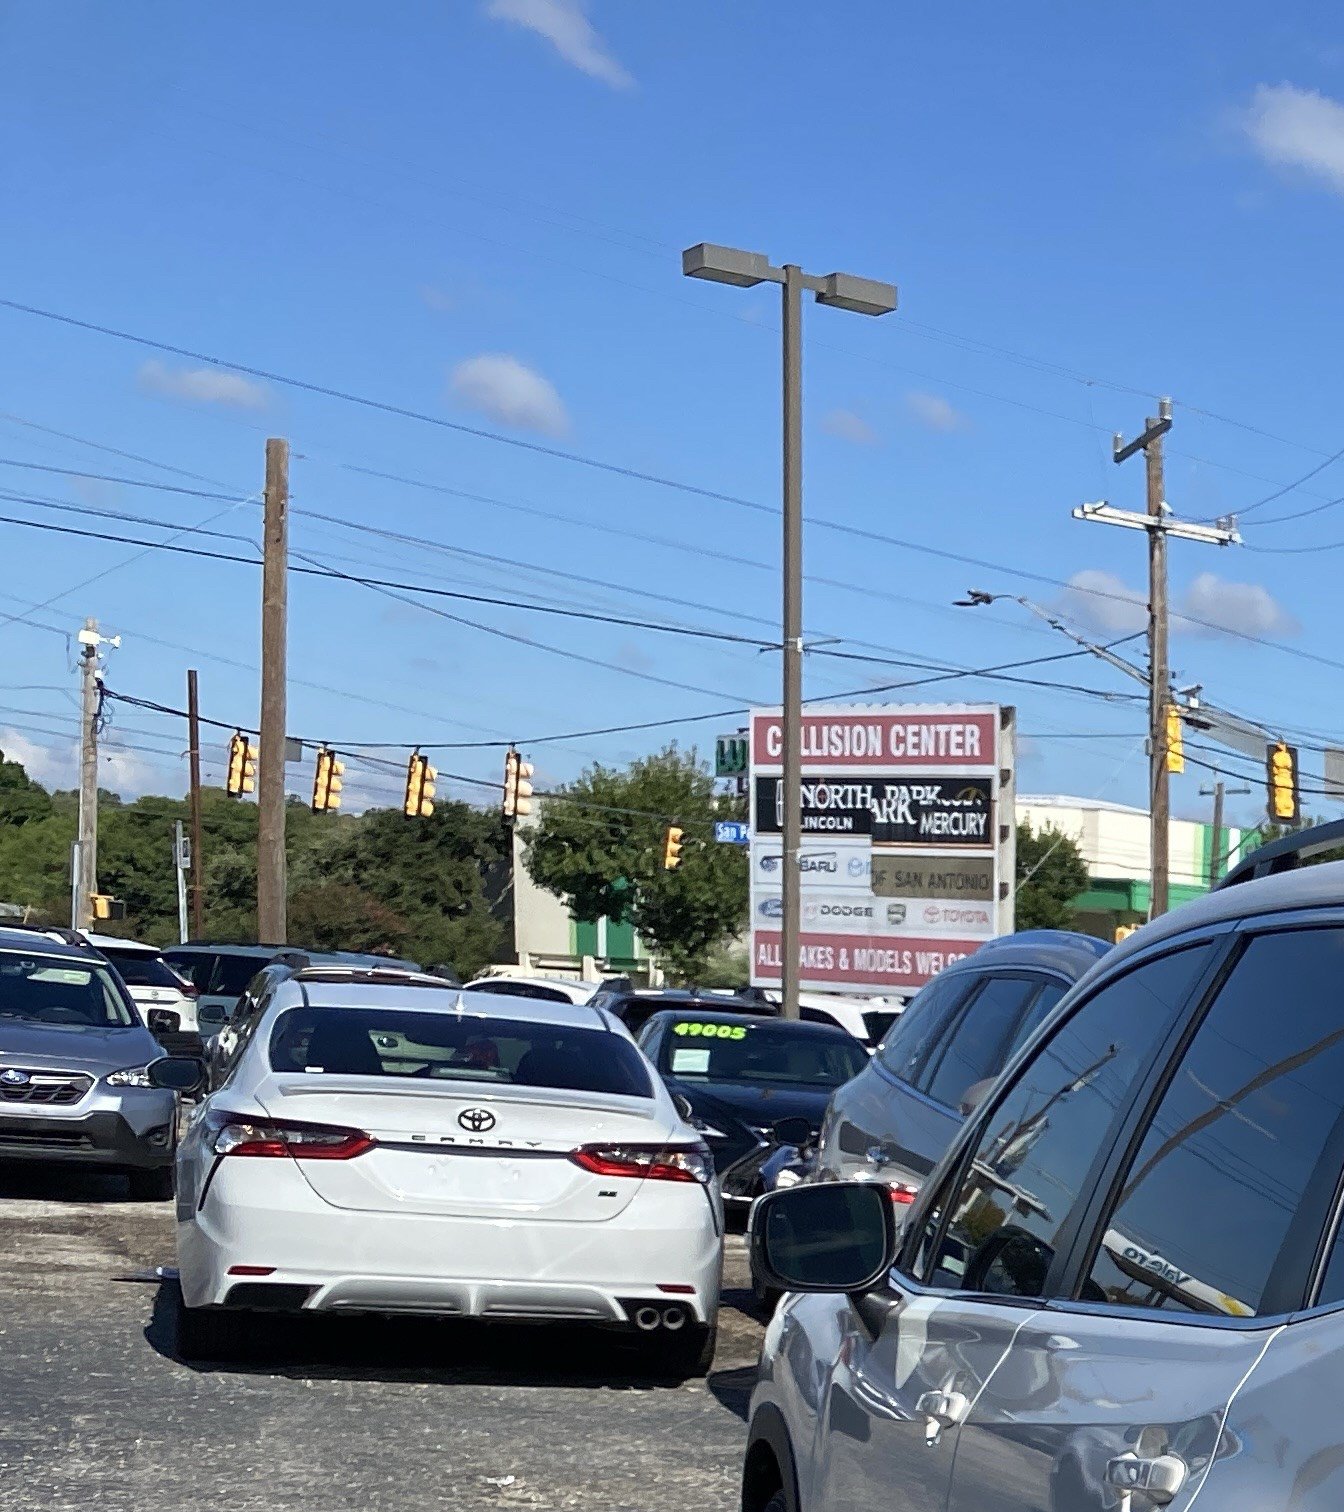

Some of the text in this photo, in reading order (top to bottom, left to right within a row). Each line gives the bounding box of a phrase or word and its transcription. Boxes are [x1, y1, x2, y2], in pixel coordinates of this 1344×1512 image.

[767, 724, 882, 757] CLLISION
[889, 723, 982, 757] CENTER
[800, 784, 872, 809] NORTH
[801, 815, 853, 830] INCOLN
[919, 811, 988, 836] MERCURY
[799, 860, 838, 873] BARU
[894, 869, 923, 889] SAN
[820, 905, 874, 918] DODGE
[799, 945, 834, 970] AKES
[839, 948, 849, 971] &
[854, 947, 912, 975] MODELS
[674, 1022, 746, 1040] 49005
